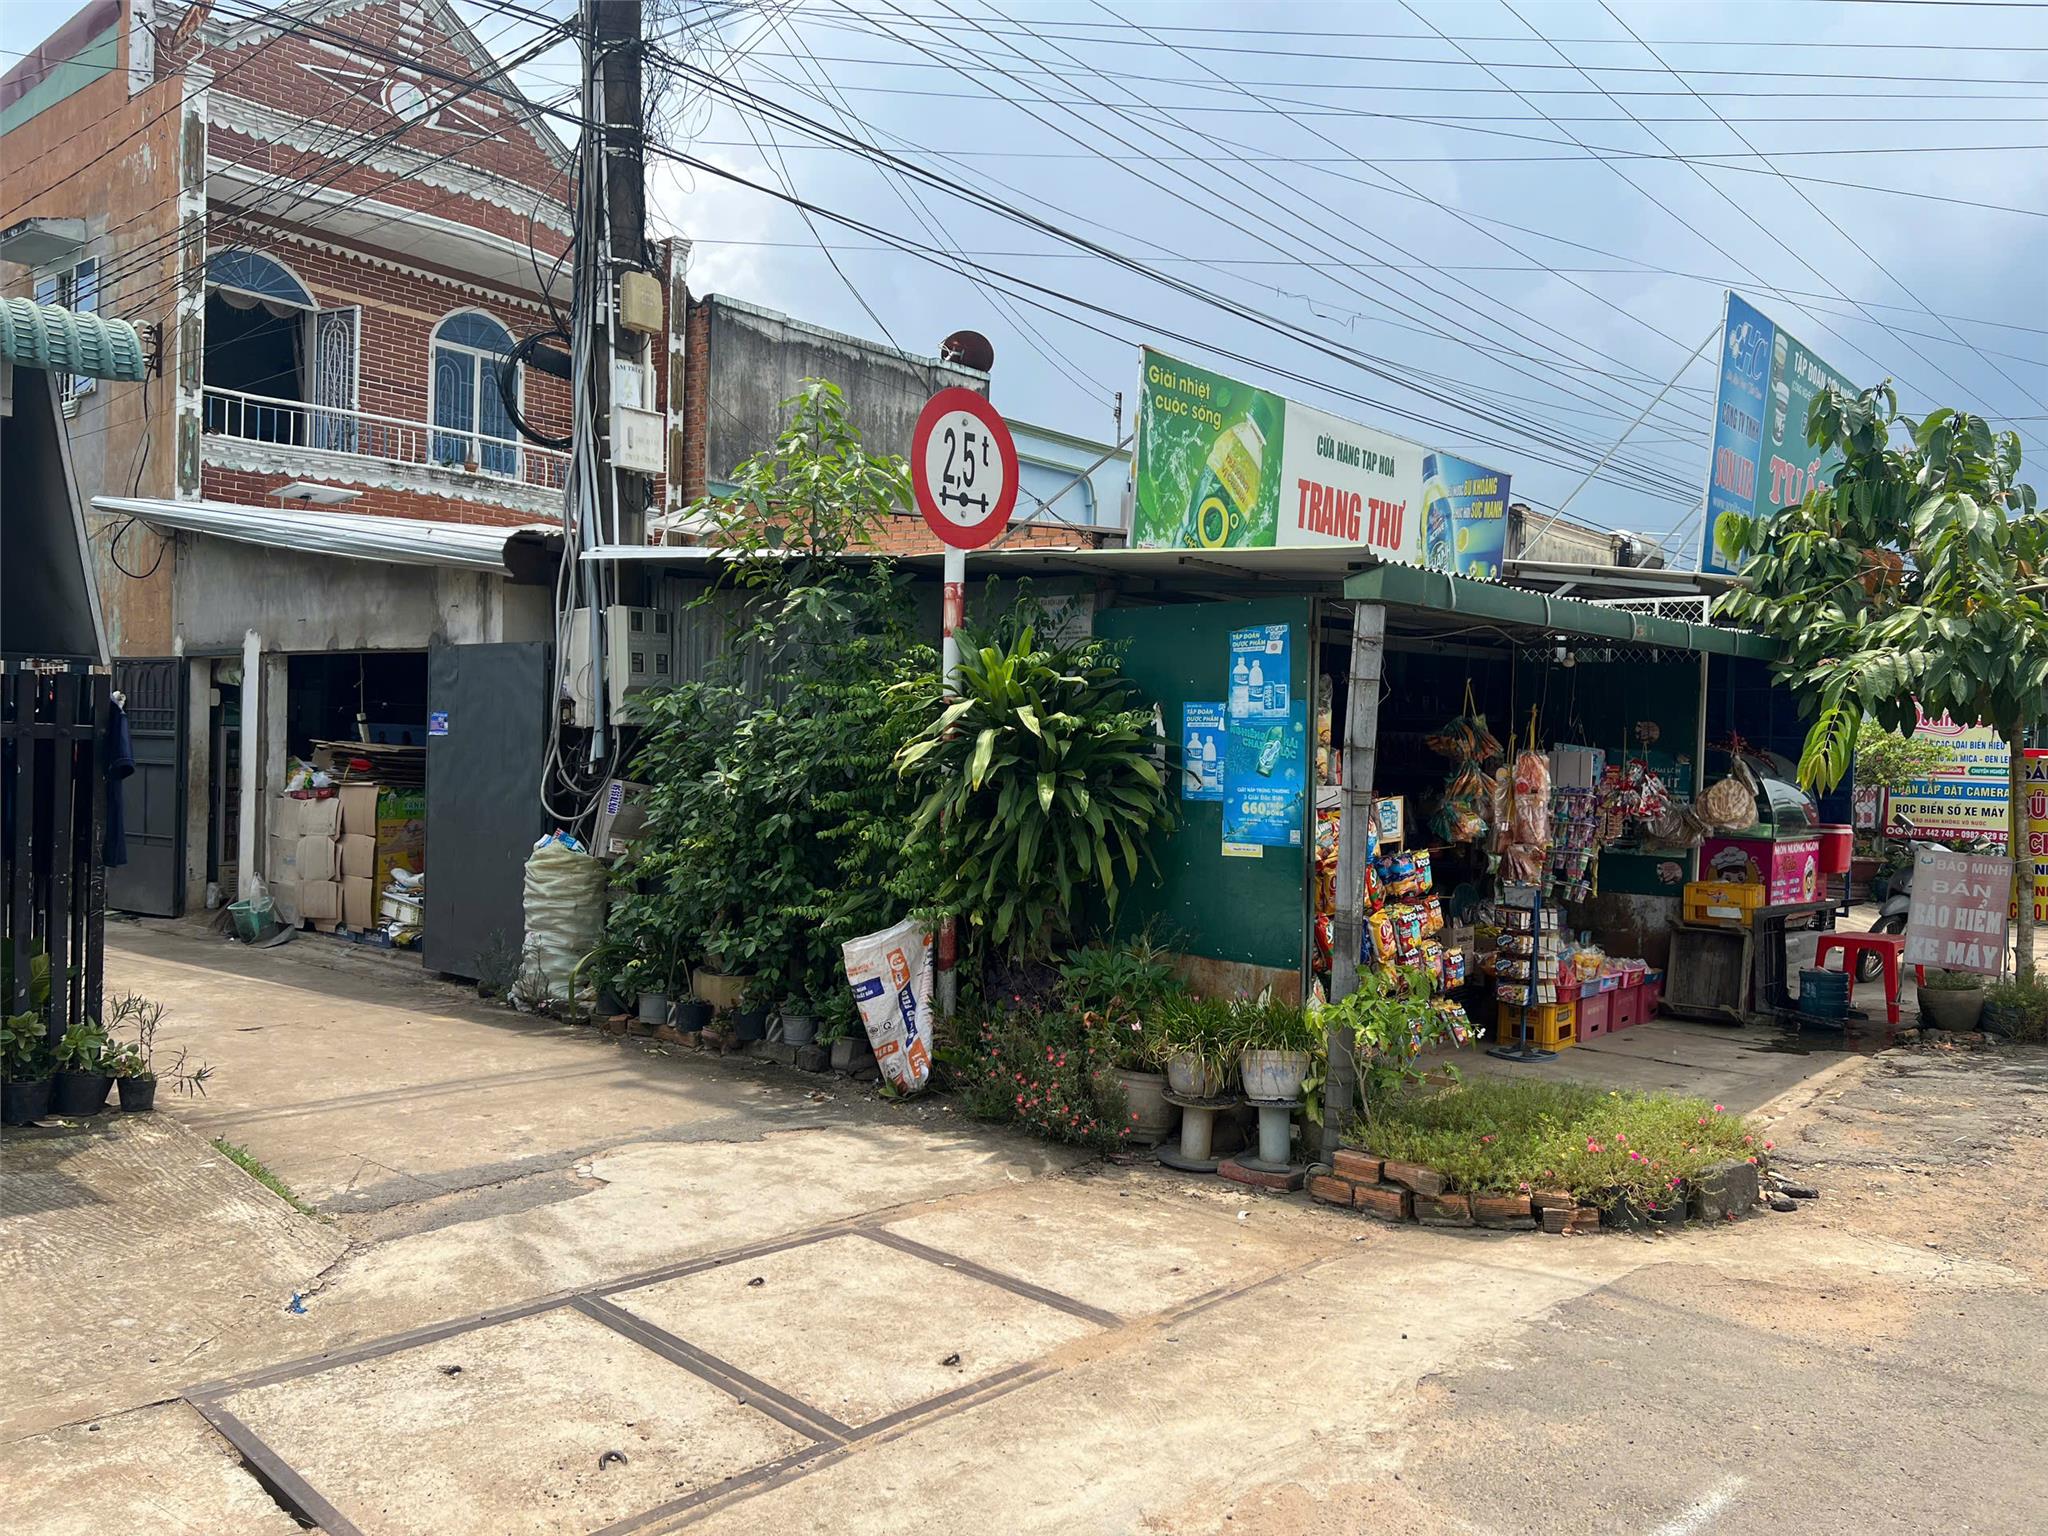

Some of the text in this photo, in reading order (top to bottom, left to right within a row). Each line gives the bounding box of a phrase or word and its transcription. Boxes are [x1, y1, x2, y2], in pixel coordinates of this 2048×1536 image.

[1148, 365, 1211, 402] Giải nhiệt
[1155, 395, 1222, 431] cuộc sống
[1316, 432, 1395, 478] CỬA HÀNG TẠP HOÁ
[1297, 478, 1362, 541] TRANG
[1367, 497, 1406, 551] THƯ
[1961, 754, 1978, 763] MICA
[1242, 801, 1266, 815] 660
[1947, 803, 1961, 816] SỐ
[1964, 806, 1978, 817] XE
[1981, 805, 2005, 818] MÁY
[1926, 829, 1939, 838] 442
[1971, 863, 2009, 876] MINH
[1401, 912, 1417, 923] POCA
[1945, 937, 1999, 970] MÁY
